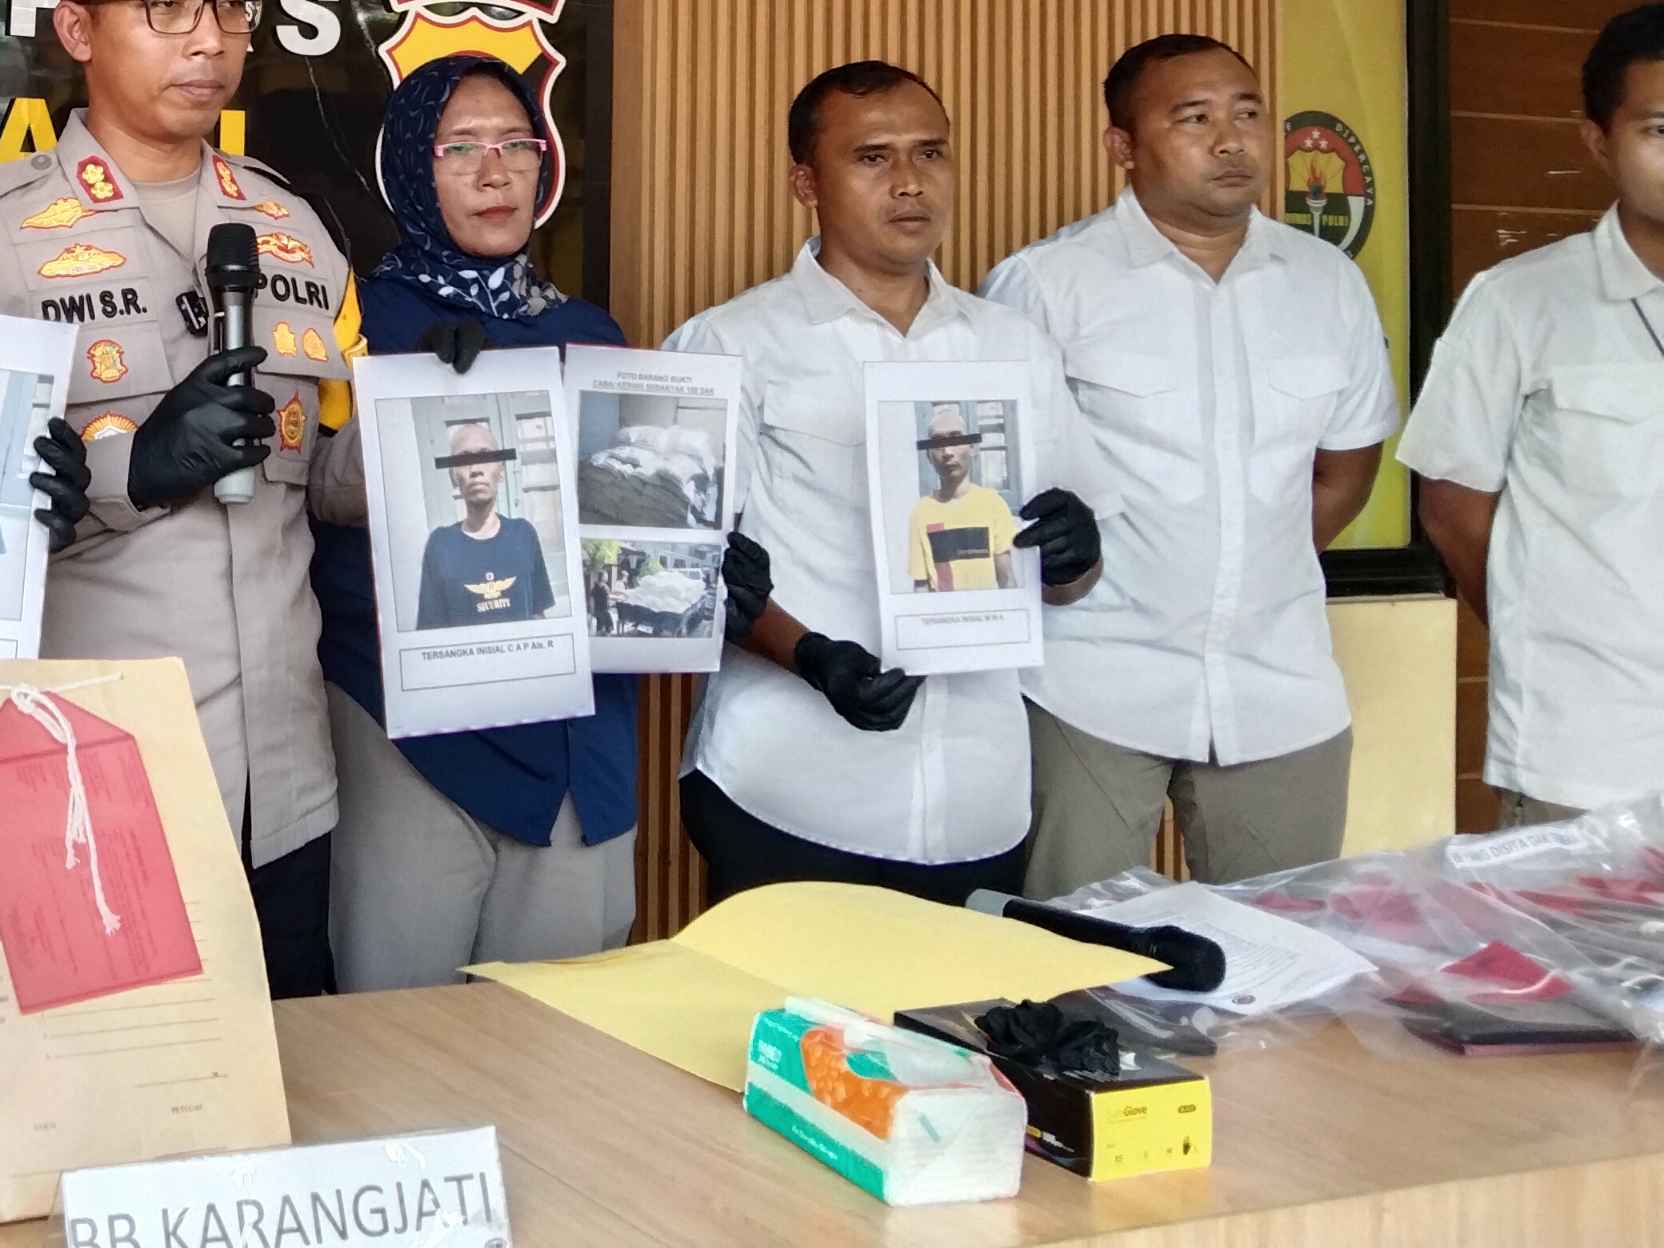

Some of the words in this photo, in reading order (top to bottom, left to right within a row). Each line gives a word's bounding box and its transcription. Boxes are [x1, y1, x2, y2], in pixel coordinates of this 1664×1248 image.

[42, 292, 95, 323] DWI
[99, 287, 148, 319] S.R.
[422, 648, 475, 661] TERSANGKA
[161, 1172, 492, 1248] KARANGJATI
